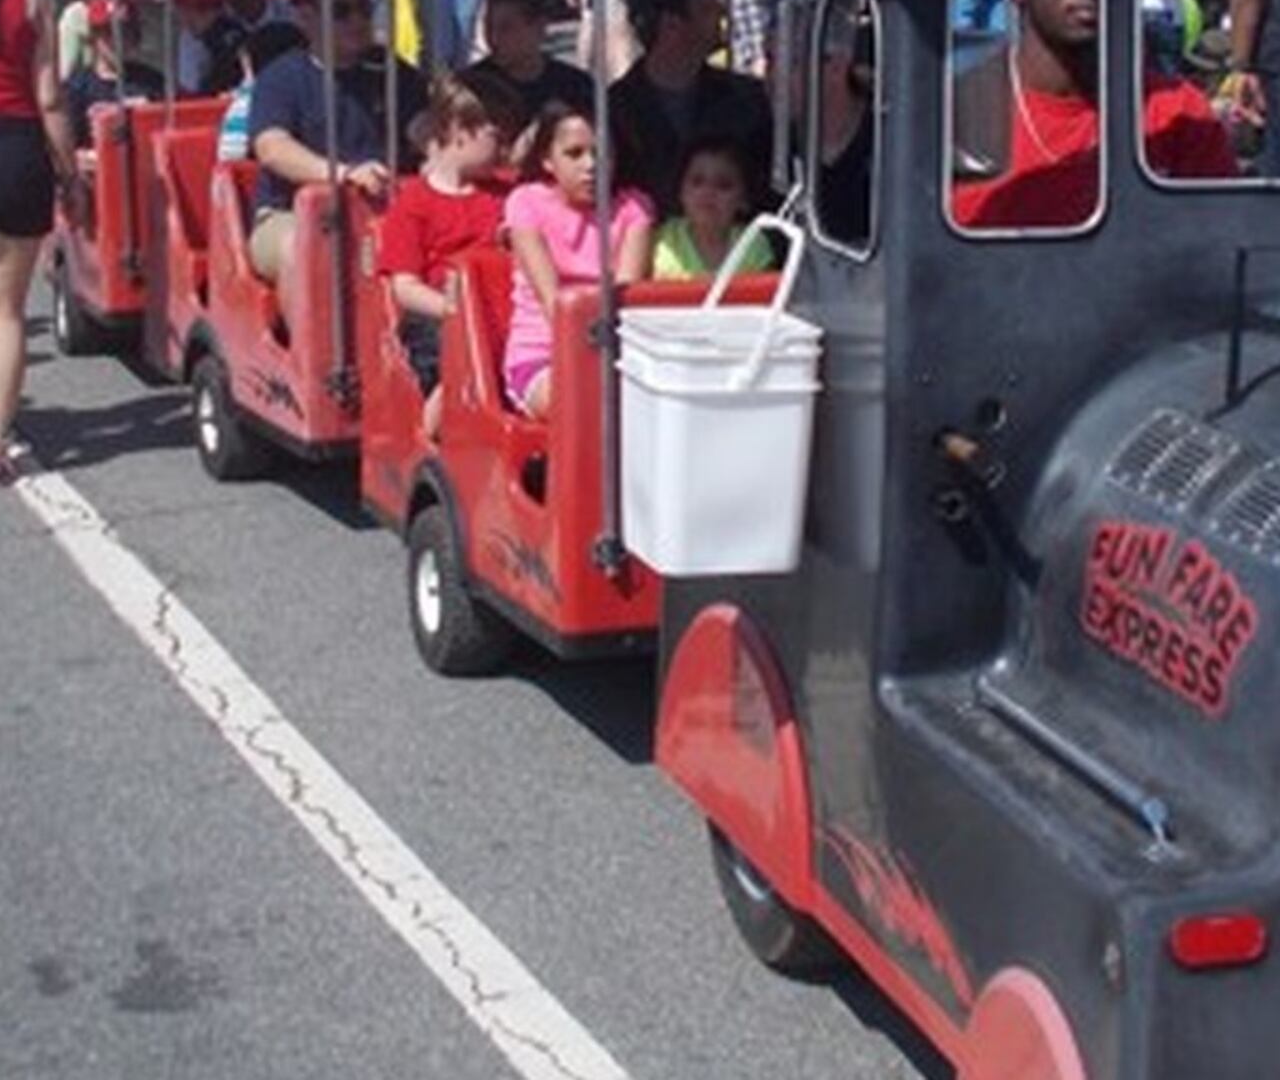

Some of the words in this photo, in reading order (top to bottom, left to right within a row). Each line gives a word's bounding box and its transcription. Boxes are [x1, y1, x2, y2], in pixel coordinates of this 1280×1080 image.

[1084, 581, 1226, 708] EXPRESS
[1091, 528, 1172, 586] FUN
[1171, 544, 1253, 666] FARE
